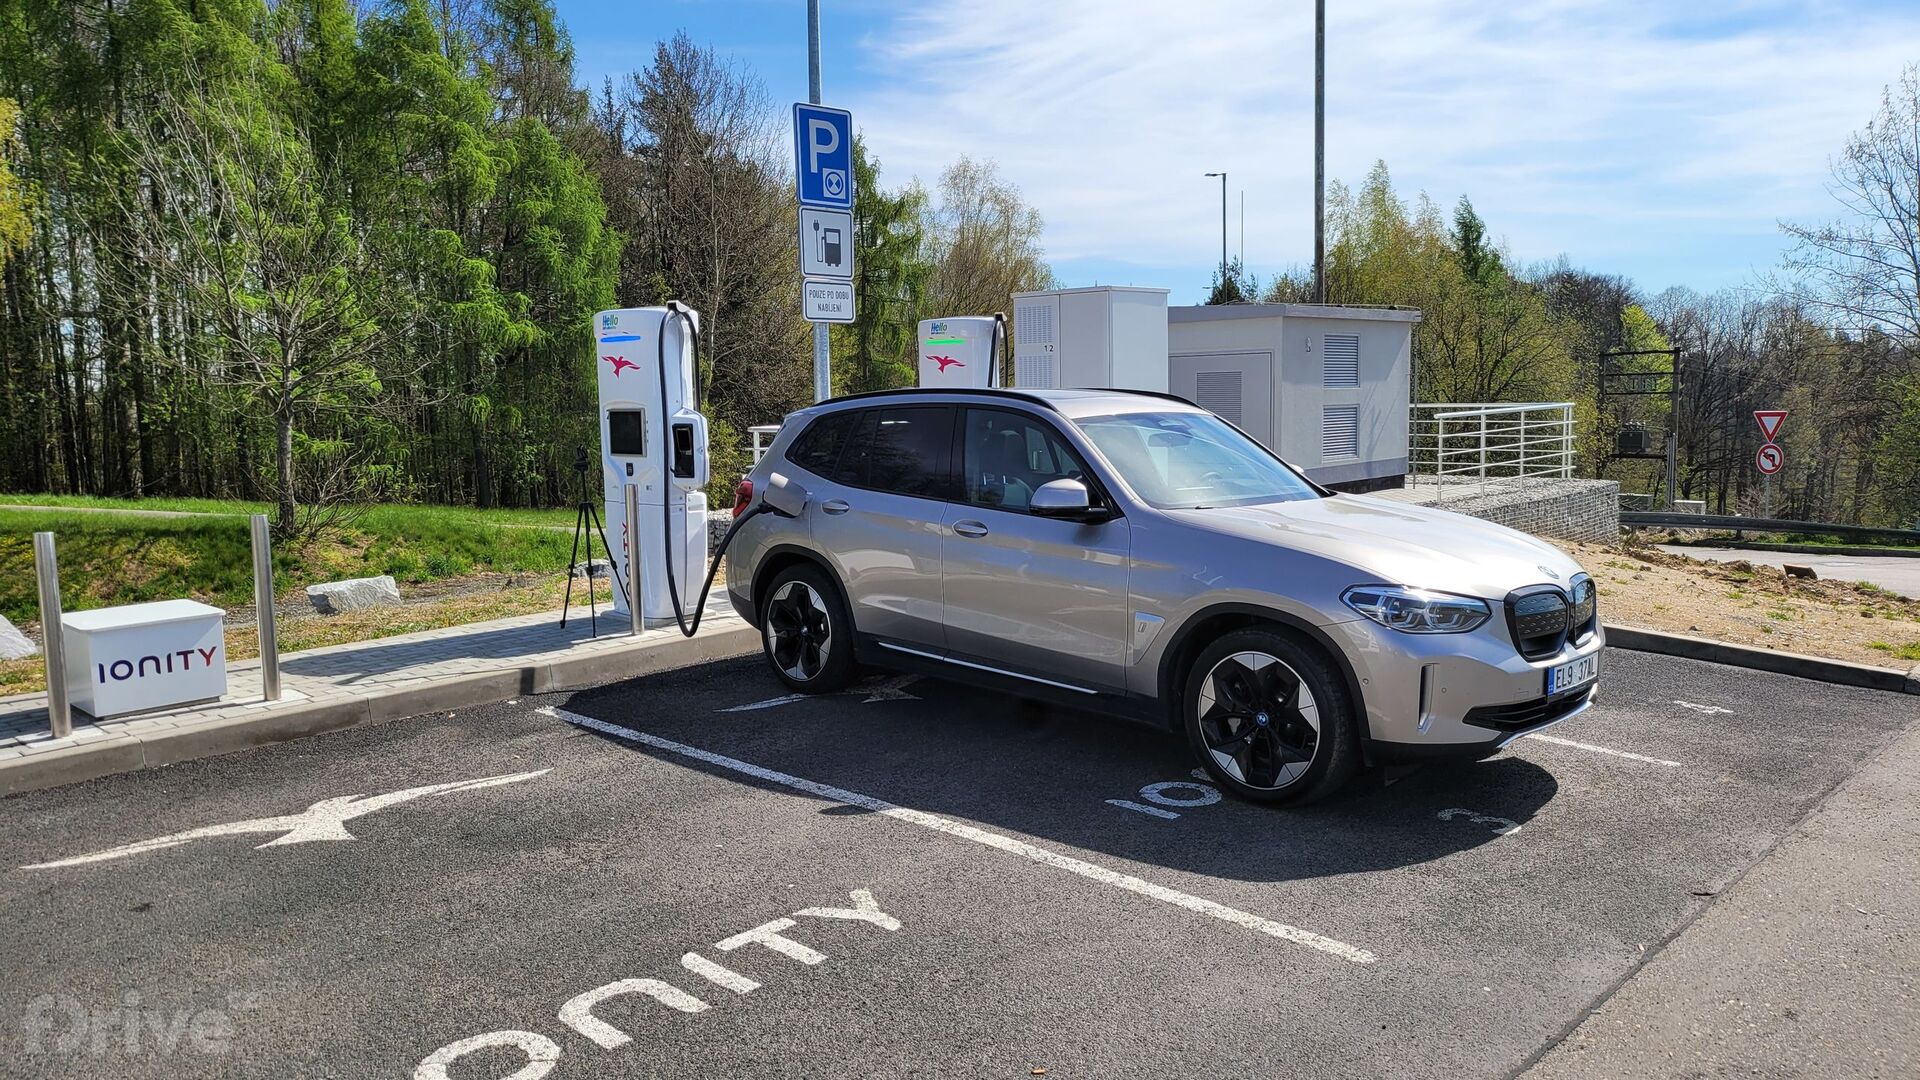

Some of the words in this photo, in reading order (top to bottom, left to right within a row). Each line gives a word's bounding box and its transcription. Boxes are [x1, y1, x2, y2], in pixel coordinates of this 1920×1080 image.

[809, 119, 840, 173] P
[808, 289, 826, 299] POUZE
[827, 291, 835, 299] PO
[835, 291, 850, 300] DOBU
[817, 301, 842, 312] NABÍJENÍ
[98, 646, 217, 684] IONITY
[1556, 666, 1573, 689] EL9
